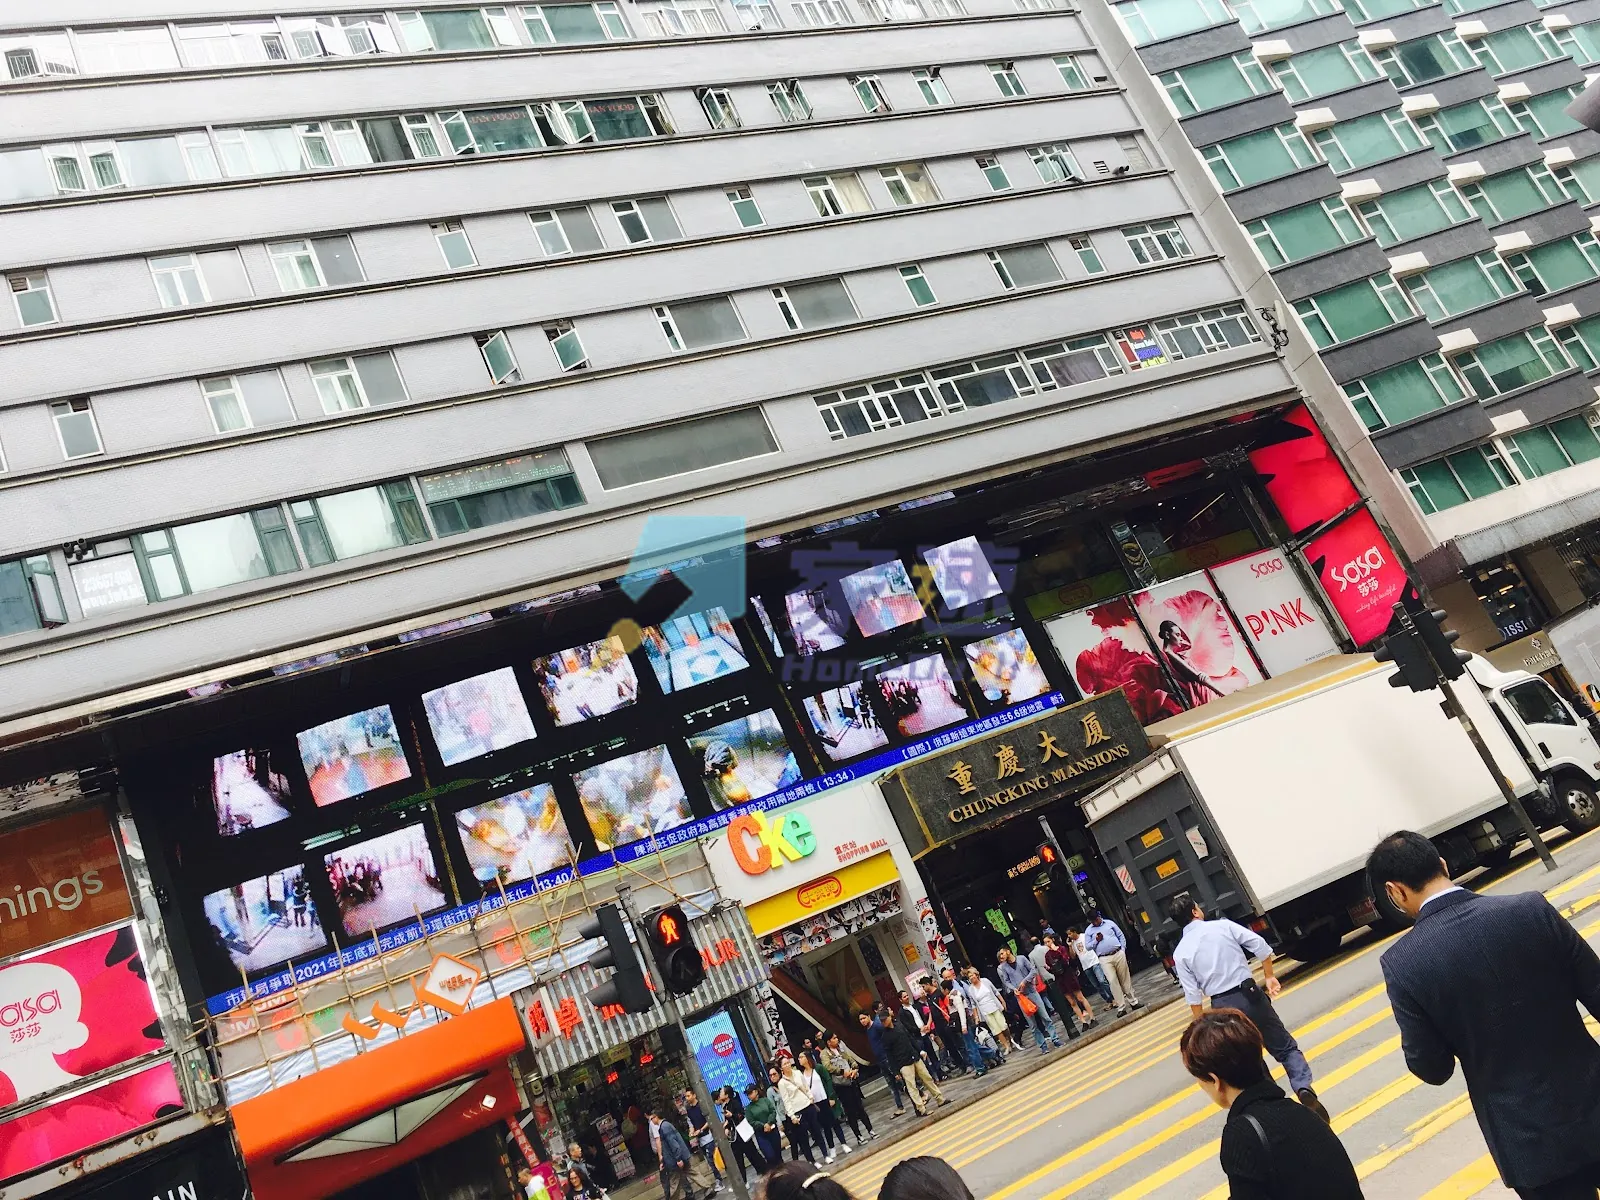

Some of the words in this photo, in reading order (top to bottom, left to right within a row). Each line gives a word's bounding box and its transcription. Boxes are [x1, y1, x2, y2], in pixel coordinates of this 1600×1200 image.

[1357, 577, 1379, 597] 莎莎
[949, 775, 1049, 823] CHUNGKING
[1051, 744, 1130, 785] MANSIONS
[837, 845, 870, 863] SHOPPING
[870, 838, 888, 851] MALL
[10, 1022, 41, 1044] 莎莎
